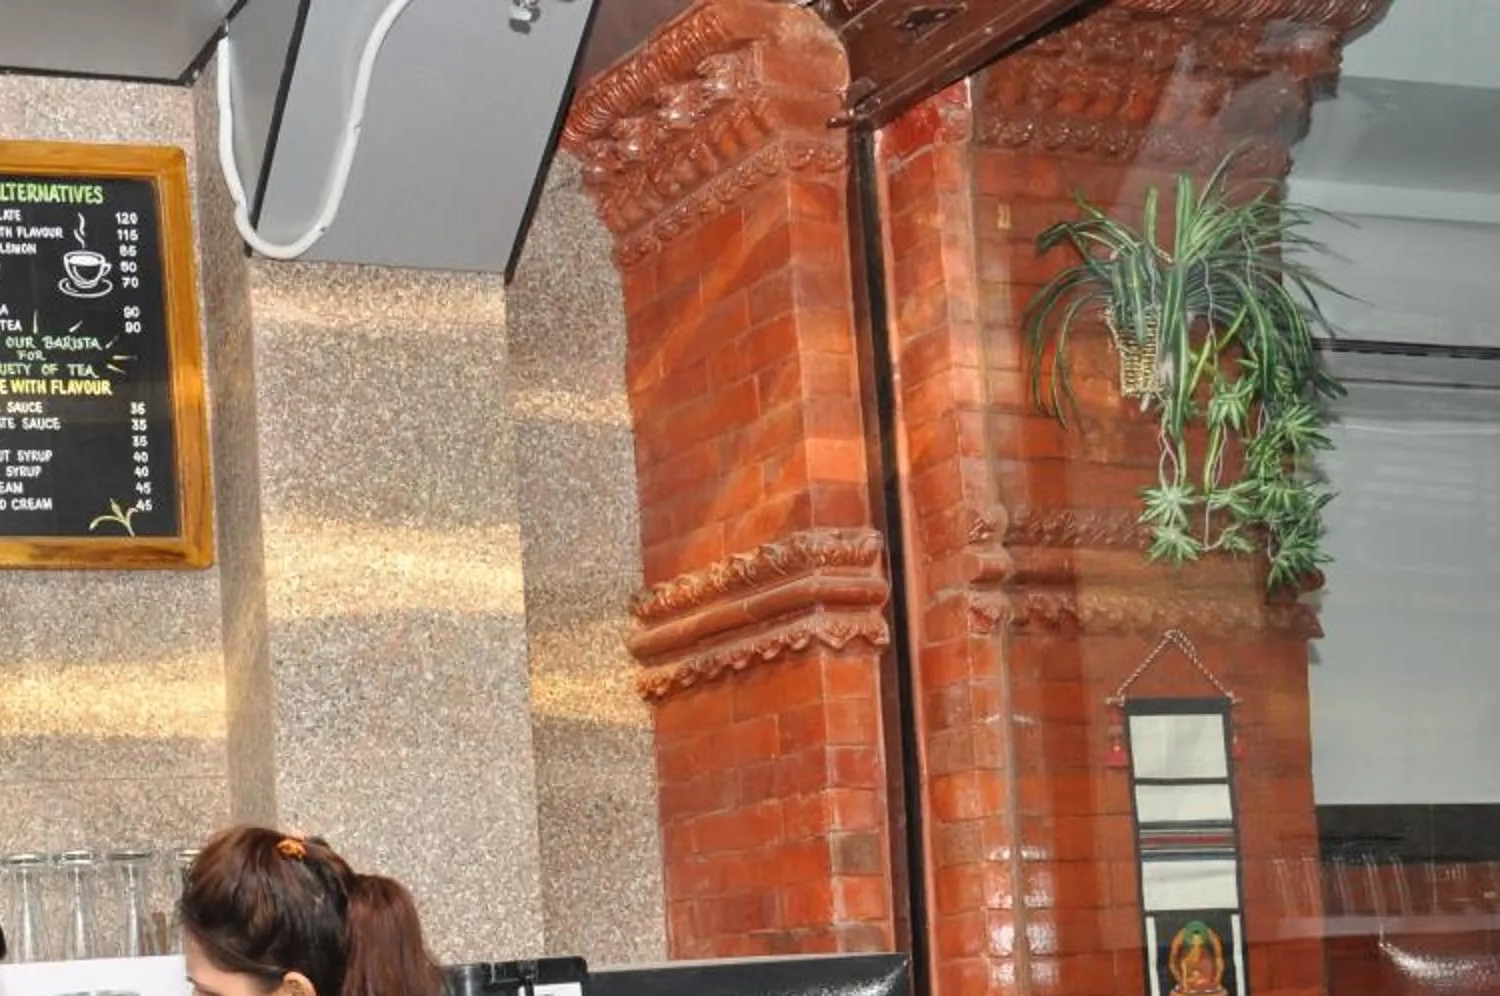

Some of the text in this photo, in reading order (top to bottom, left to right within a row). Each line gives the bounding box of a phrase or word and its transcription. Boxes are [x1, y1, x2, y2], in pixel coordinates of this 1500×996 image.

[16, 227, 63, 238] FLAVOUR
[122, 278, 139, 288] 70
[0, 320, 22, 331] TEA
[5, 337, 36, 348] OUR
[42, 336, 103, 351] BARISTA
[42, 364, 58, 375] OF
[68, 364, 99, 379] TEA
[11, 379, 47, 394] WITH
[51, 380, 112, 395] FLAVOUR
[7, 402, 43, 413] SAUCE
[22, 418, 61, 430] SAUCE
[132, 420, 147, 431] 35
[17, 450, 52, 462] SYRUP
[6, 466, 42, 477] SYRUP
[134, 467, 148, 478] 40
[136, 482, 152, 494] 45
[12, 499, 53, 510] CREAM
